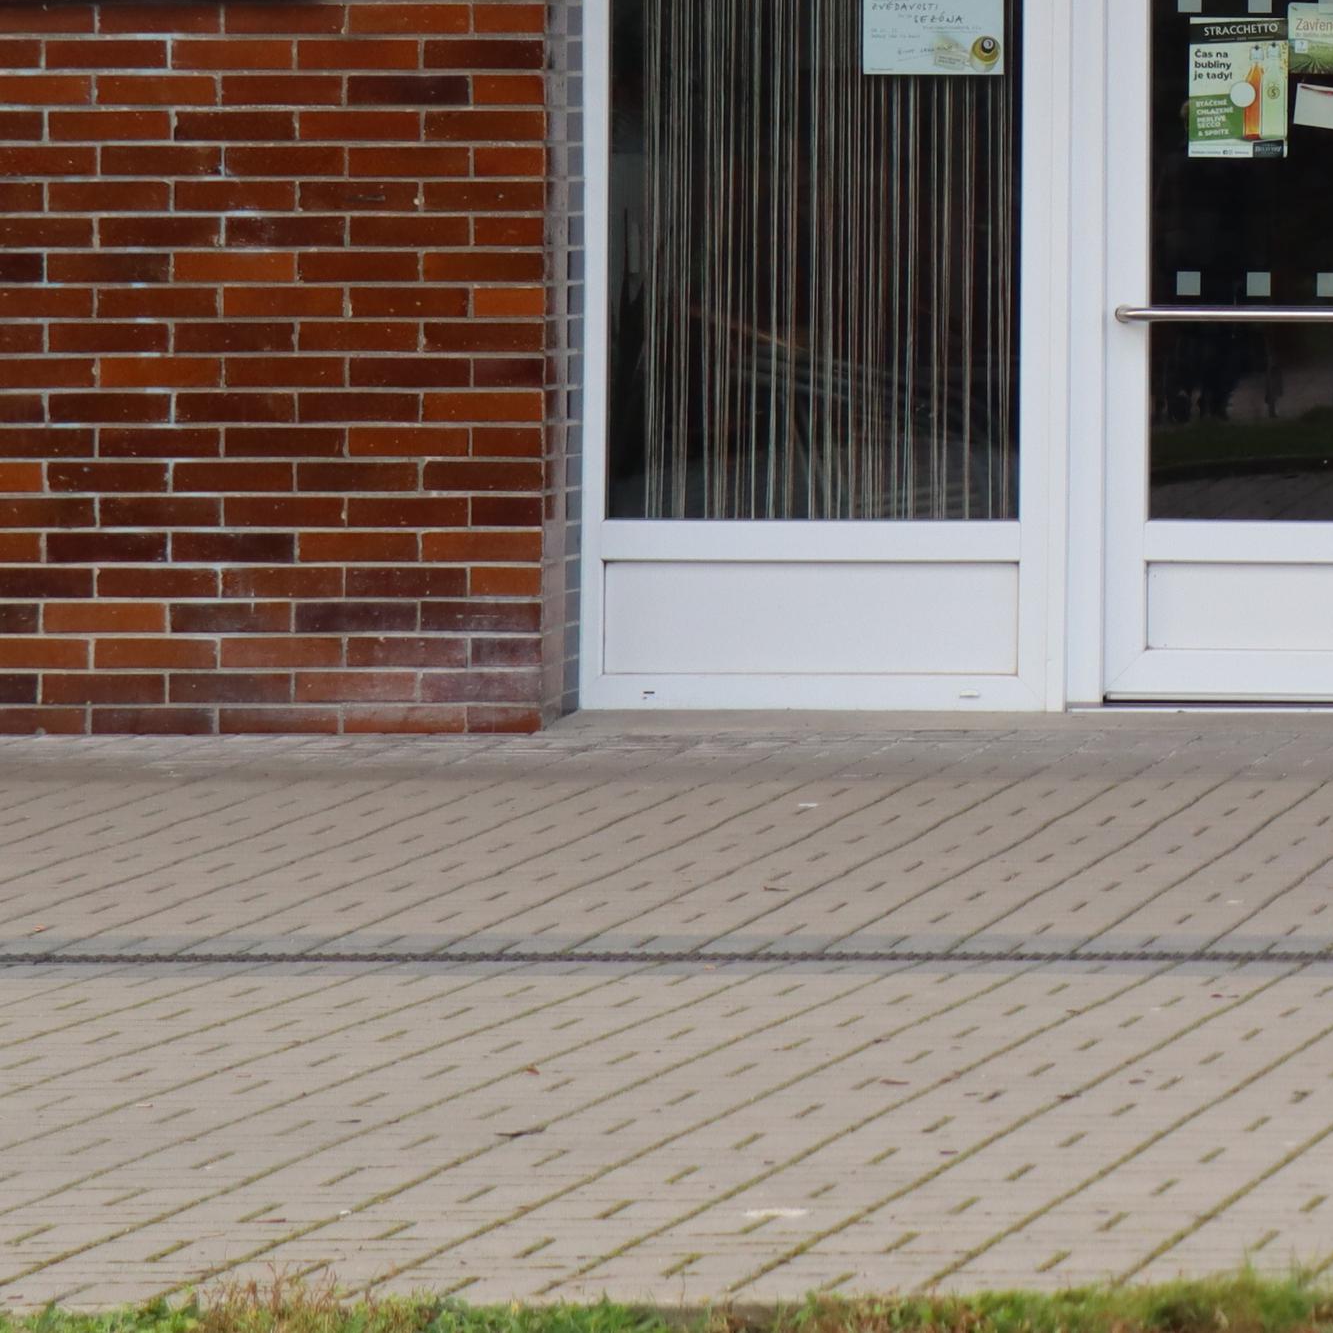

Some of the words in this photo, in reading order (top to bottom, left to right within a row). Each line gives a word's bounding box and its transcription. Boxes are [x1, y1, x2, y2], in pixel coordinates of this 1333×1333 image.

[1203, 23, 1279, 36] STRACCHETTO
[1194, 48, 1213, 59] Čas
[1216, 50, 1229, 59] na
[1193, 70, 1204, 81] je
